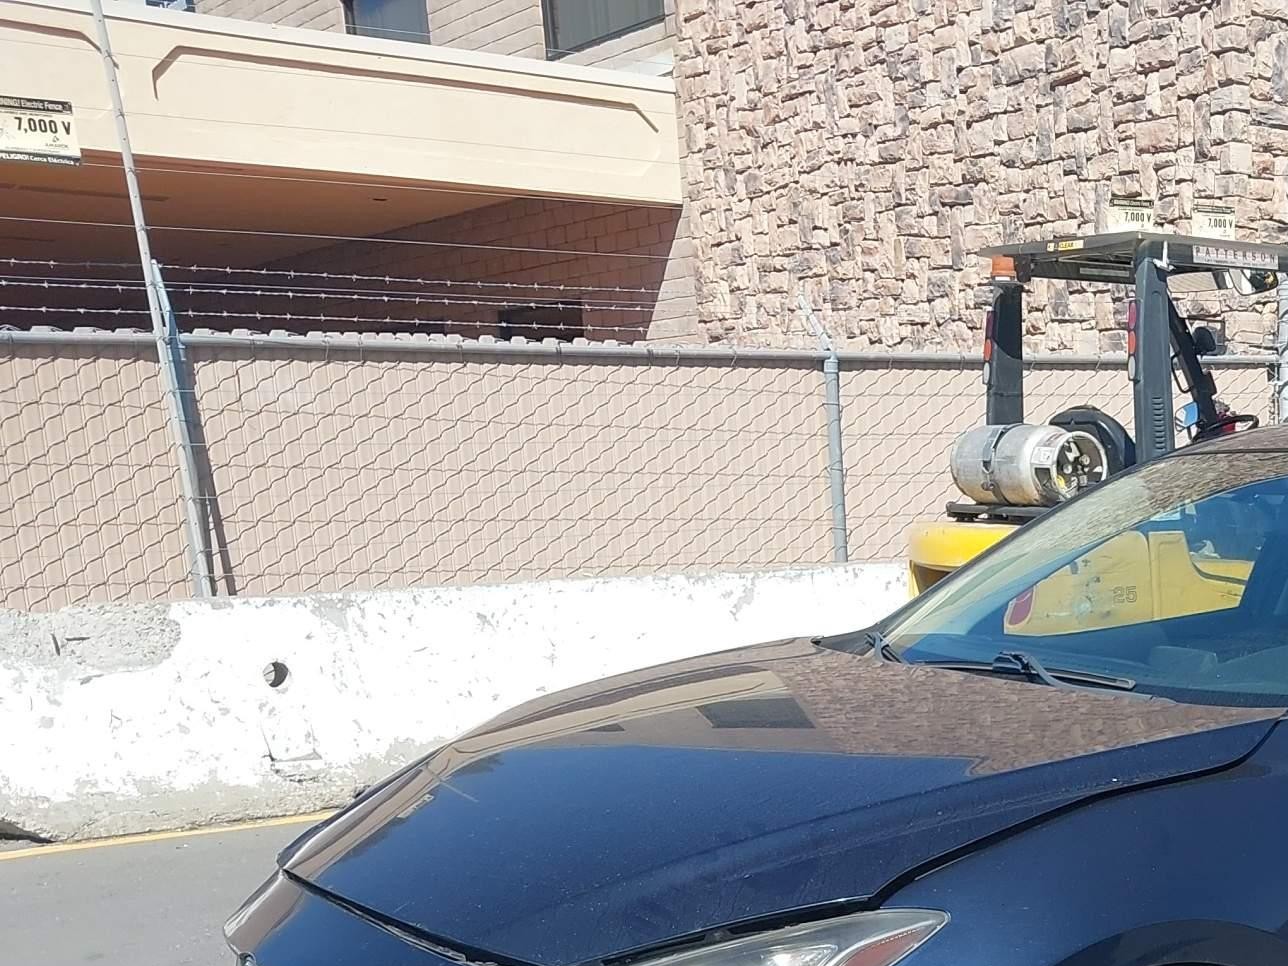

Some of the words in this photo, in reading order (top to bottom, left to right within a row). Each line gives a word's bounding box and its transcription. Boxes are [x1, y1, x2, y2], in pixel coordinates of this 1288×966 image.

[14, 116, 58, 134] 7,000
[61, 120, 71, 135] V
[1124, 211, 1145, 223] 7,000
[1147, 212, 1152, 223] V
[1208, 217, 1227, 229] 7,000
[1229, 219, 1233, 229] V
[1195, 246, 1275, 264] PATTERSON
[1112, 586, 1138, 604] 25
